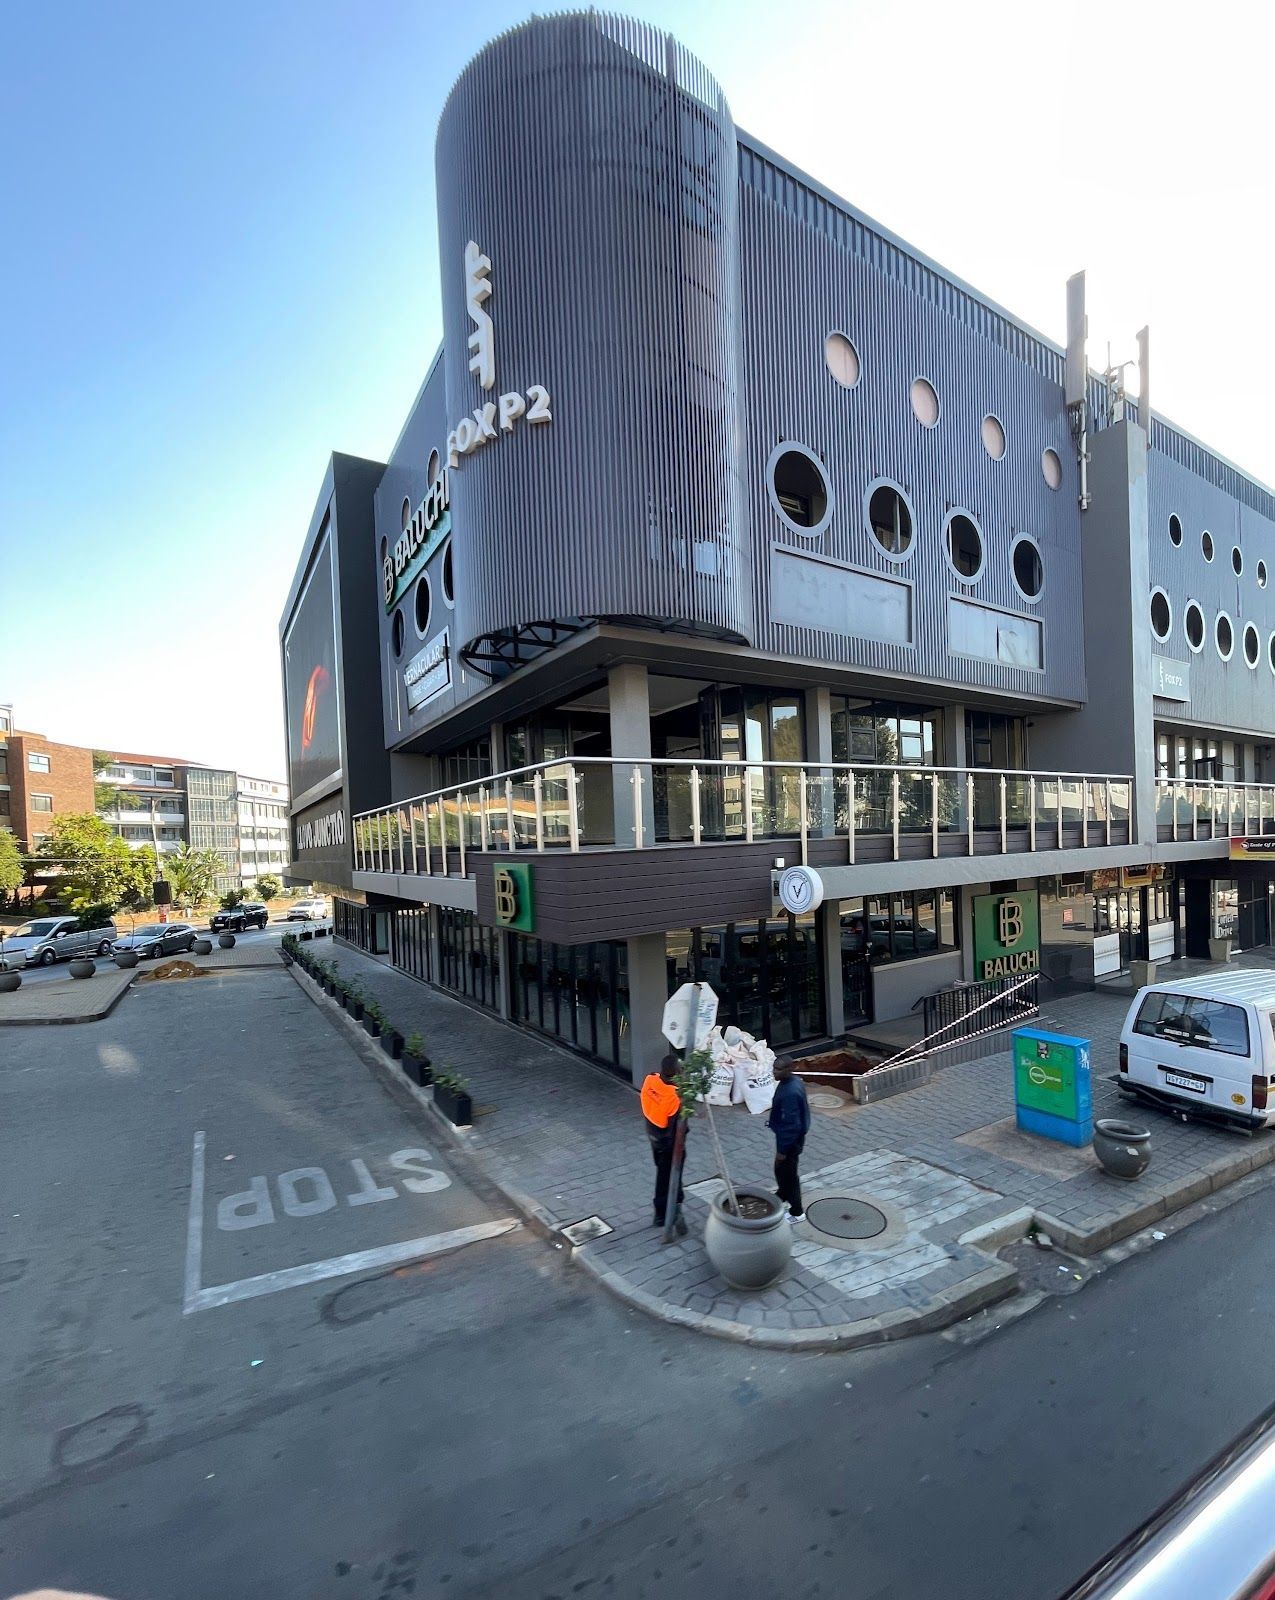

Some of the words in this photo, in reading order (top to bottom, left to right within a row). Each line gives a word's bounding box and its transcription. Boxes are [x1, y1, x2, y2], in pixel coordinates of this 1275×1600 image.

[394, 463, 450, 577] BALUCHI
[313, 810, 346, 848] JUNCTIO
[984, 949, 1039, 980] BALUCHI
[217, 1149, 452, 1231] STOP
